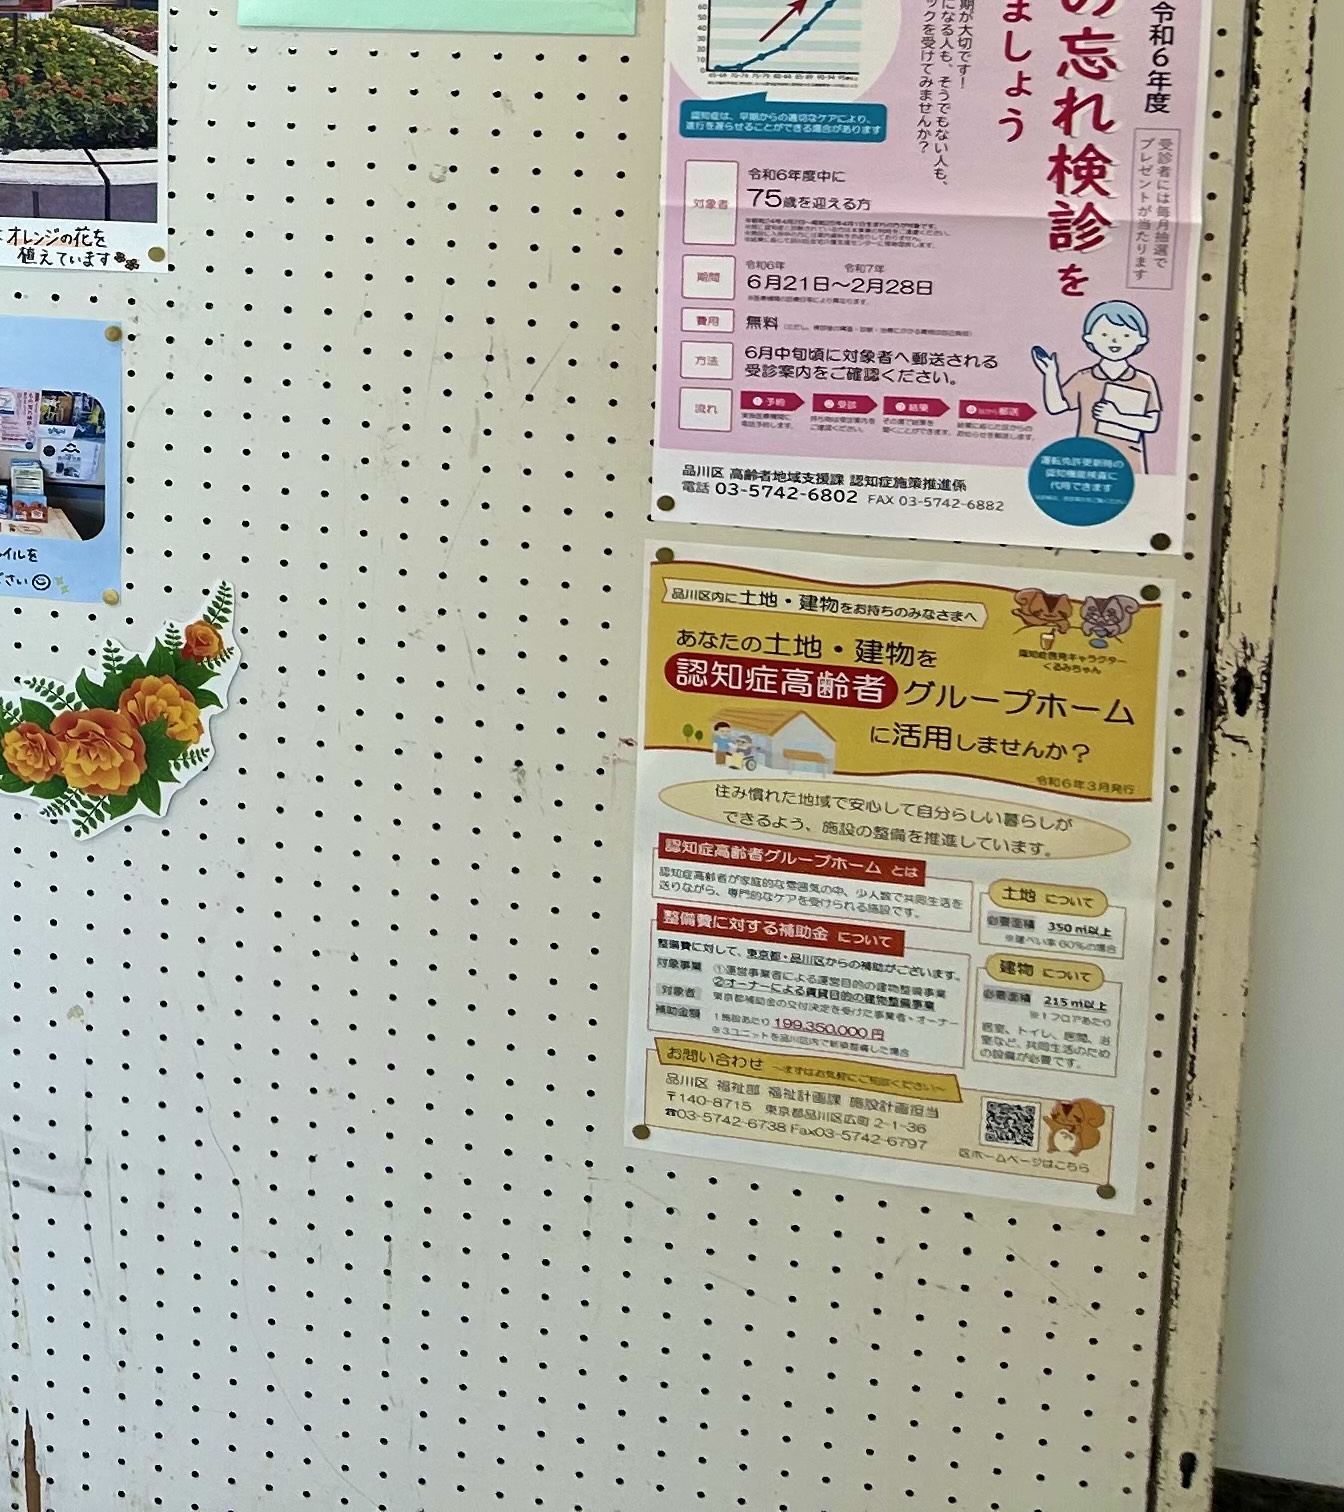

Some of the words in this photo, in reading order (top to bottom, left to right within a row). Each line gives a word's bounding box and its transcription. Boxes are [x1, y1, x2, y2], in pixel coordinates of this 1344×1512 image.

[1144, 0, 1177, 114] 令和6年度
[748, 168, 846, 183] 令和6年度中に
[693, 198, 729, 210] 対象者
[746, 188, 872, 211] 75歳を迎える方
[17, 248, 110, 267] 植えています
[746, 260, 786, 270] 令和6年
[844, 263, 885, 274] 令和7年
[745, 316, 779, 330] 無料
[695, 355, 718, 367] 方法
[744, 346, 998, 369] 6月中旬頃に対象者へ郵送される
[744, 363, 958, 386] 受診案内をご確認ください。
[681, 463, 724, 479] 品川区
[729, 467, 845, 486] 高齢者地域支援課
[849, 473, 967, 493] 認知症施策推進係
[681, 480, 710, 494] 電話
[715, 481, 859, 505] 03-5742-6802
[868, 493, 895, 506] FAX
[899, 494, 1005, 512] 03-5742-6882
[676, 628, 938, 670] あなたの土地・建物を
[675, 657, 887, 705] 認知症高齢者
[903, 679, 1136, 727] グループホーム
[870, 721, 1091, 765] に活用しませんか？
[714, 783, 1074, 833] 住み慣れた地域で安心して自分らしい暮らしが
[722, 809, 1053, 859] できるよう、施設の整備を推進しています。
[891, 864, 919, 879] とは
[1002, 886, 1036, 903] 土地
[1045, 894, 1095, 909] について
[663, 909, 829, 942] 整備費に対する補助金
[837, 931, 893, 948] について
[999, 959, 1034, 977] 建物
[1043, 968, 1092, 983] について
[667, 1046, 764, 1071] お問い合わせ
[665, 1072, 709, 1089] 品川区
[716, 1079, 761, 1096] 福祉部
